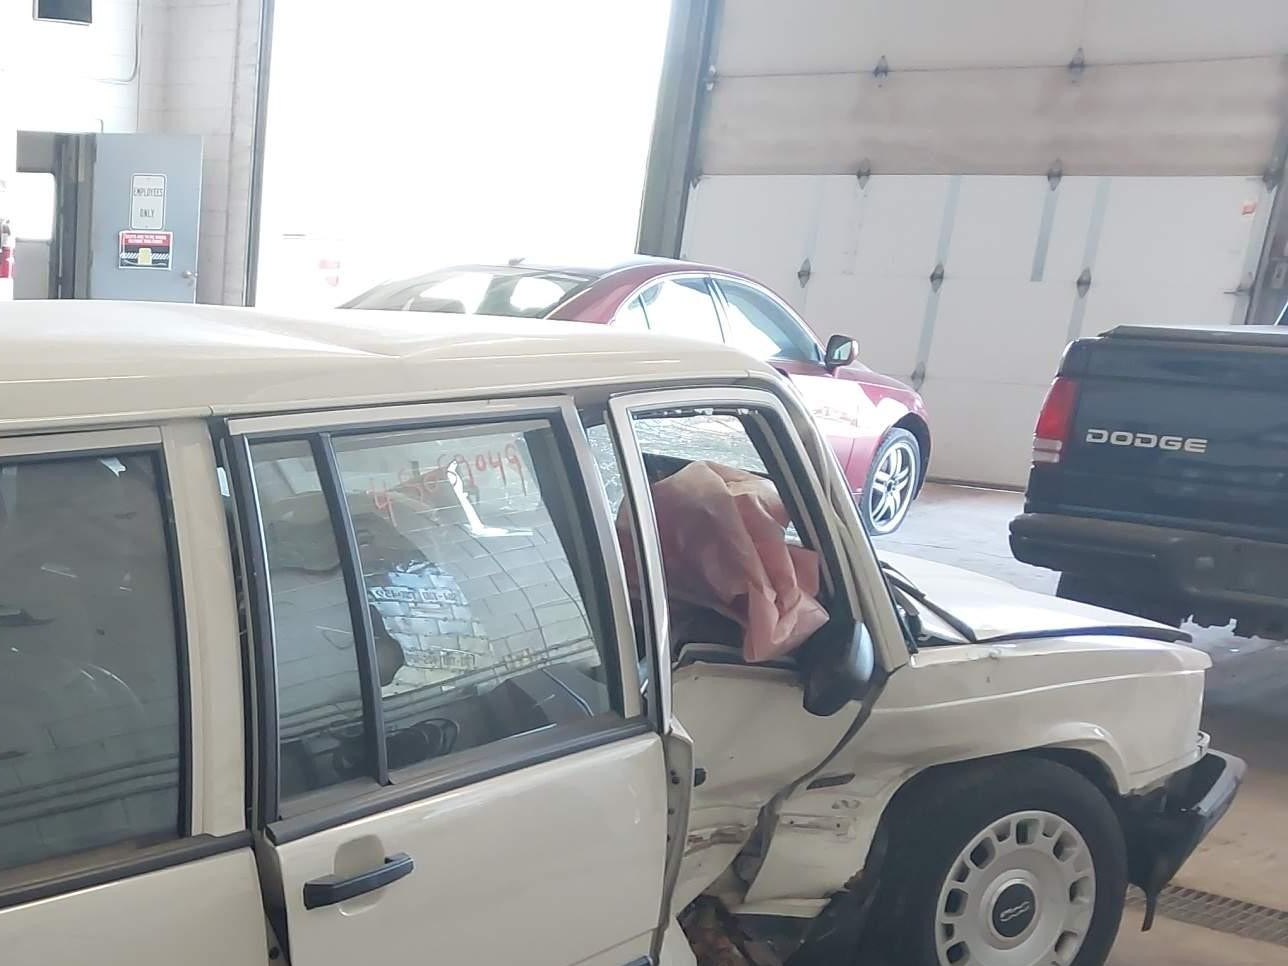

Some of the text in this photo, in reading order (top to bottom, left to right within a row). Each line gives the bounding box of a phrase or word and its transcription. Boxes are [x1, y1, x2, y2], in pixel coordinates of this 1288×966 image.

[133, 187, 163, 197] EMPLOYEES
[139, 208, 155, 217] ONLY
[1086, 428, 1208, 453] DODGE
